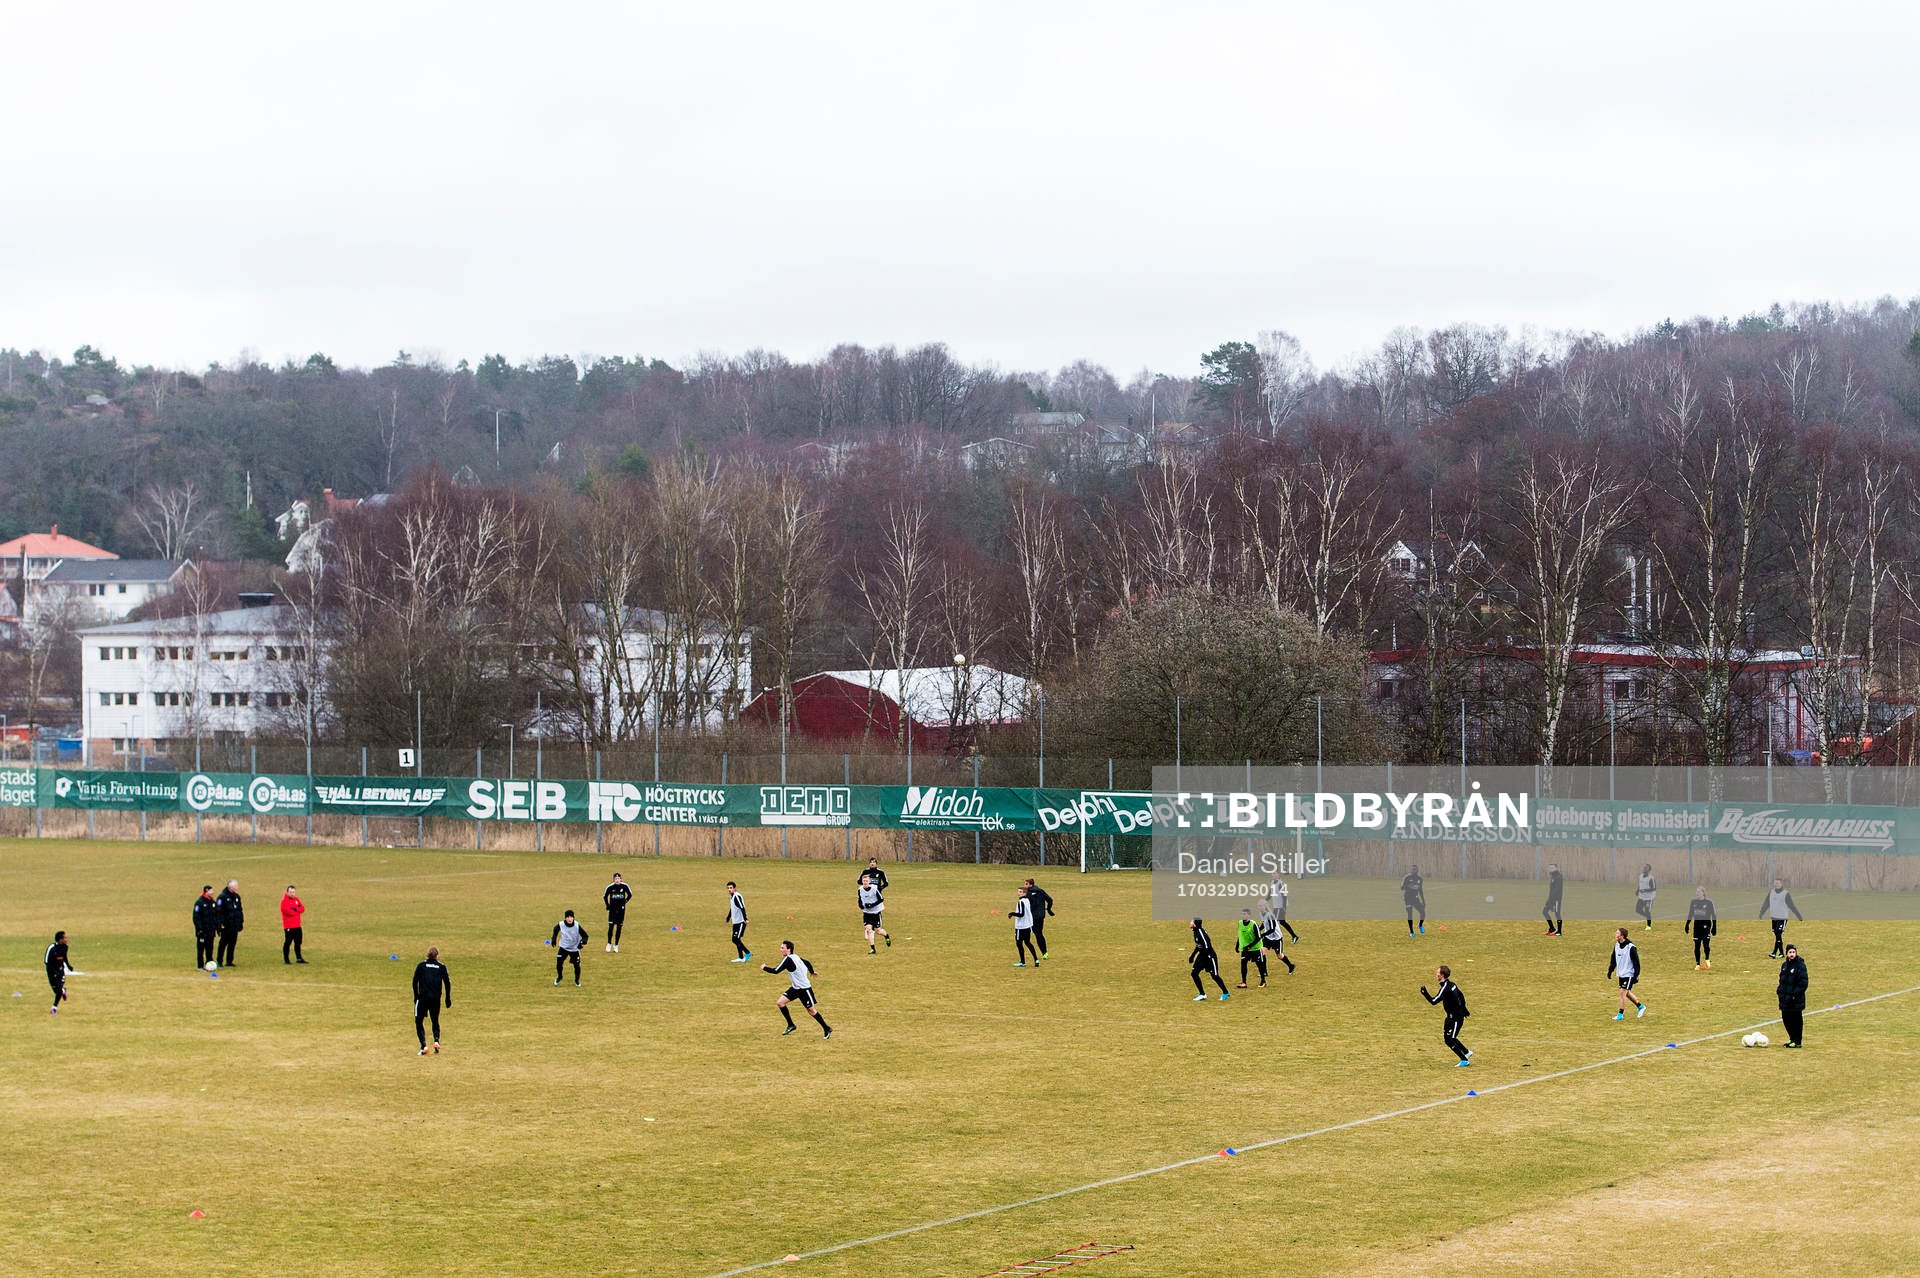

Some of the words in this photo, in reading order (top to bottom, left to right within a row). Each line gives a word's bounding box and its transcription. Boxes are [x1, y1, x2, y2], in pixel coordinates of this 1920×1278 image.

[402, 751, 411, 765] 1
[0, 768, 37, 786] stads
[0, 784, 36, 806] laget
[77, 780, 107, 795] Varis
[110, 781, 178, 800] Förvaltning
[362, 787, 411, 802] BETONG
[413, 788, 432, 801] AB
[466, 780, 567, 819] SEB
[645, 784, 725, 805] HÖGTRYCKS
[760, 787, 850, 815] DEMO
[901, 787, 984, 816] Midoh
[1037, 794, 1118, 831] Delphi
[645, 806, 697, 822] CENTER
[703, 815, 718, 823] VÄST
[719, 816, 729, 824] AB
[826, 815, 851, 825] GROUP
[1113, 796, 1193, 834] Delphi
[1535, 805, 1613, 830] göteborgs
[1617, 808, 1710, 831] glasmästeri
[1713, 808, 1896, 838] BERGKVARABUSS
[1391, 821, 1533, 843] ANDERSSON
[1535, 831, 1568, 839] GLAS
[1581, 832, 1631, 841] METALL
[1644, 834, 1710, 842] BILRUTOR
